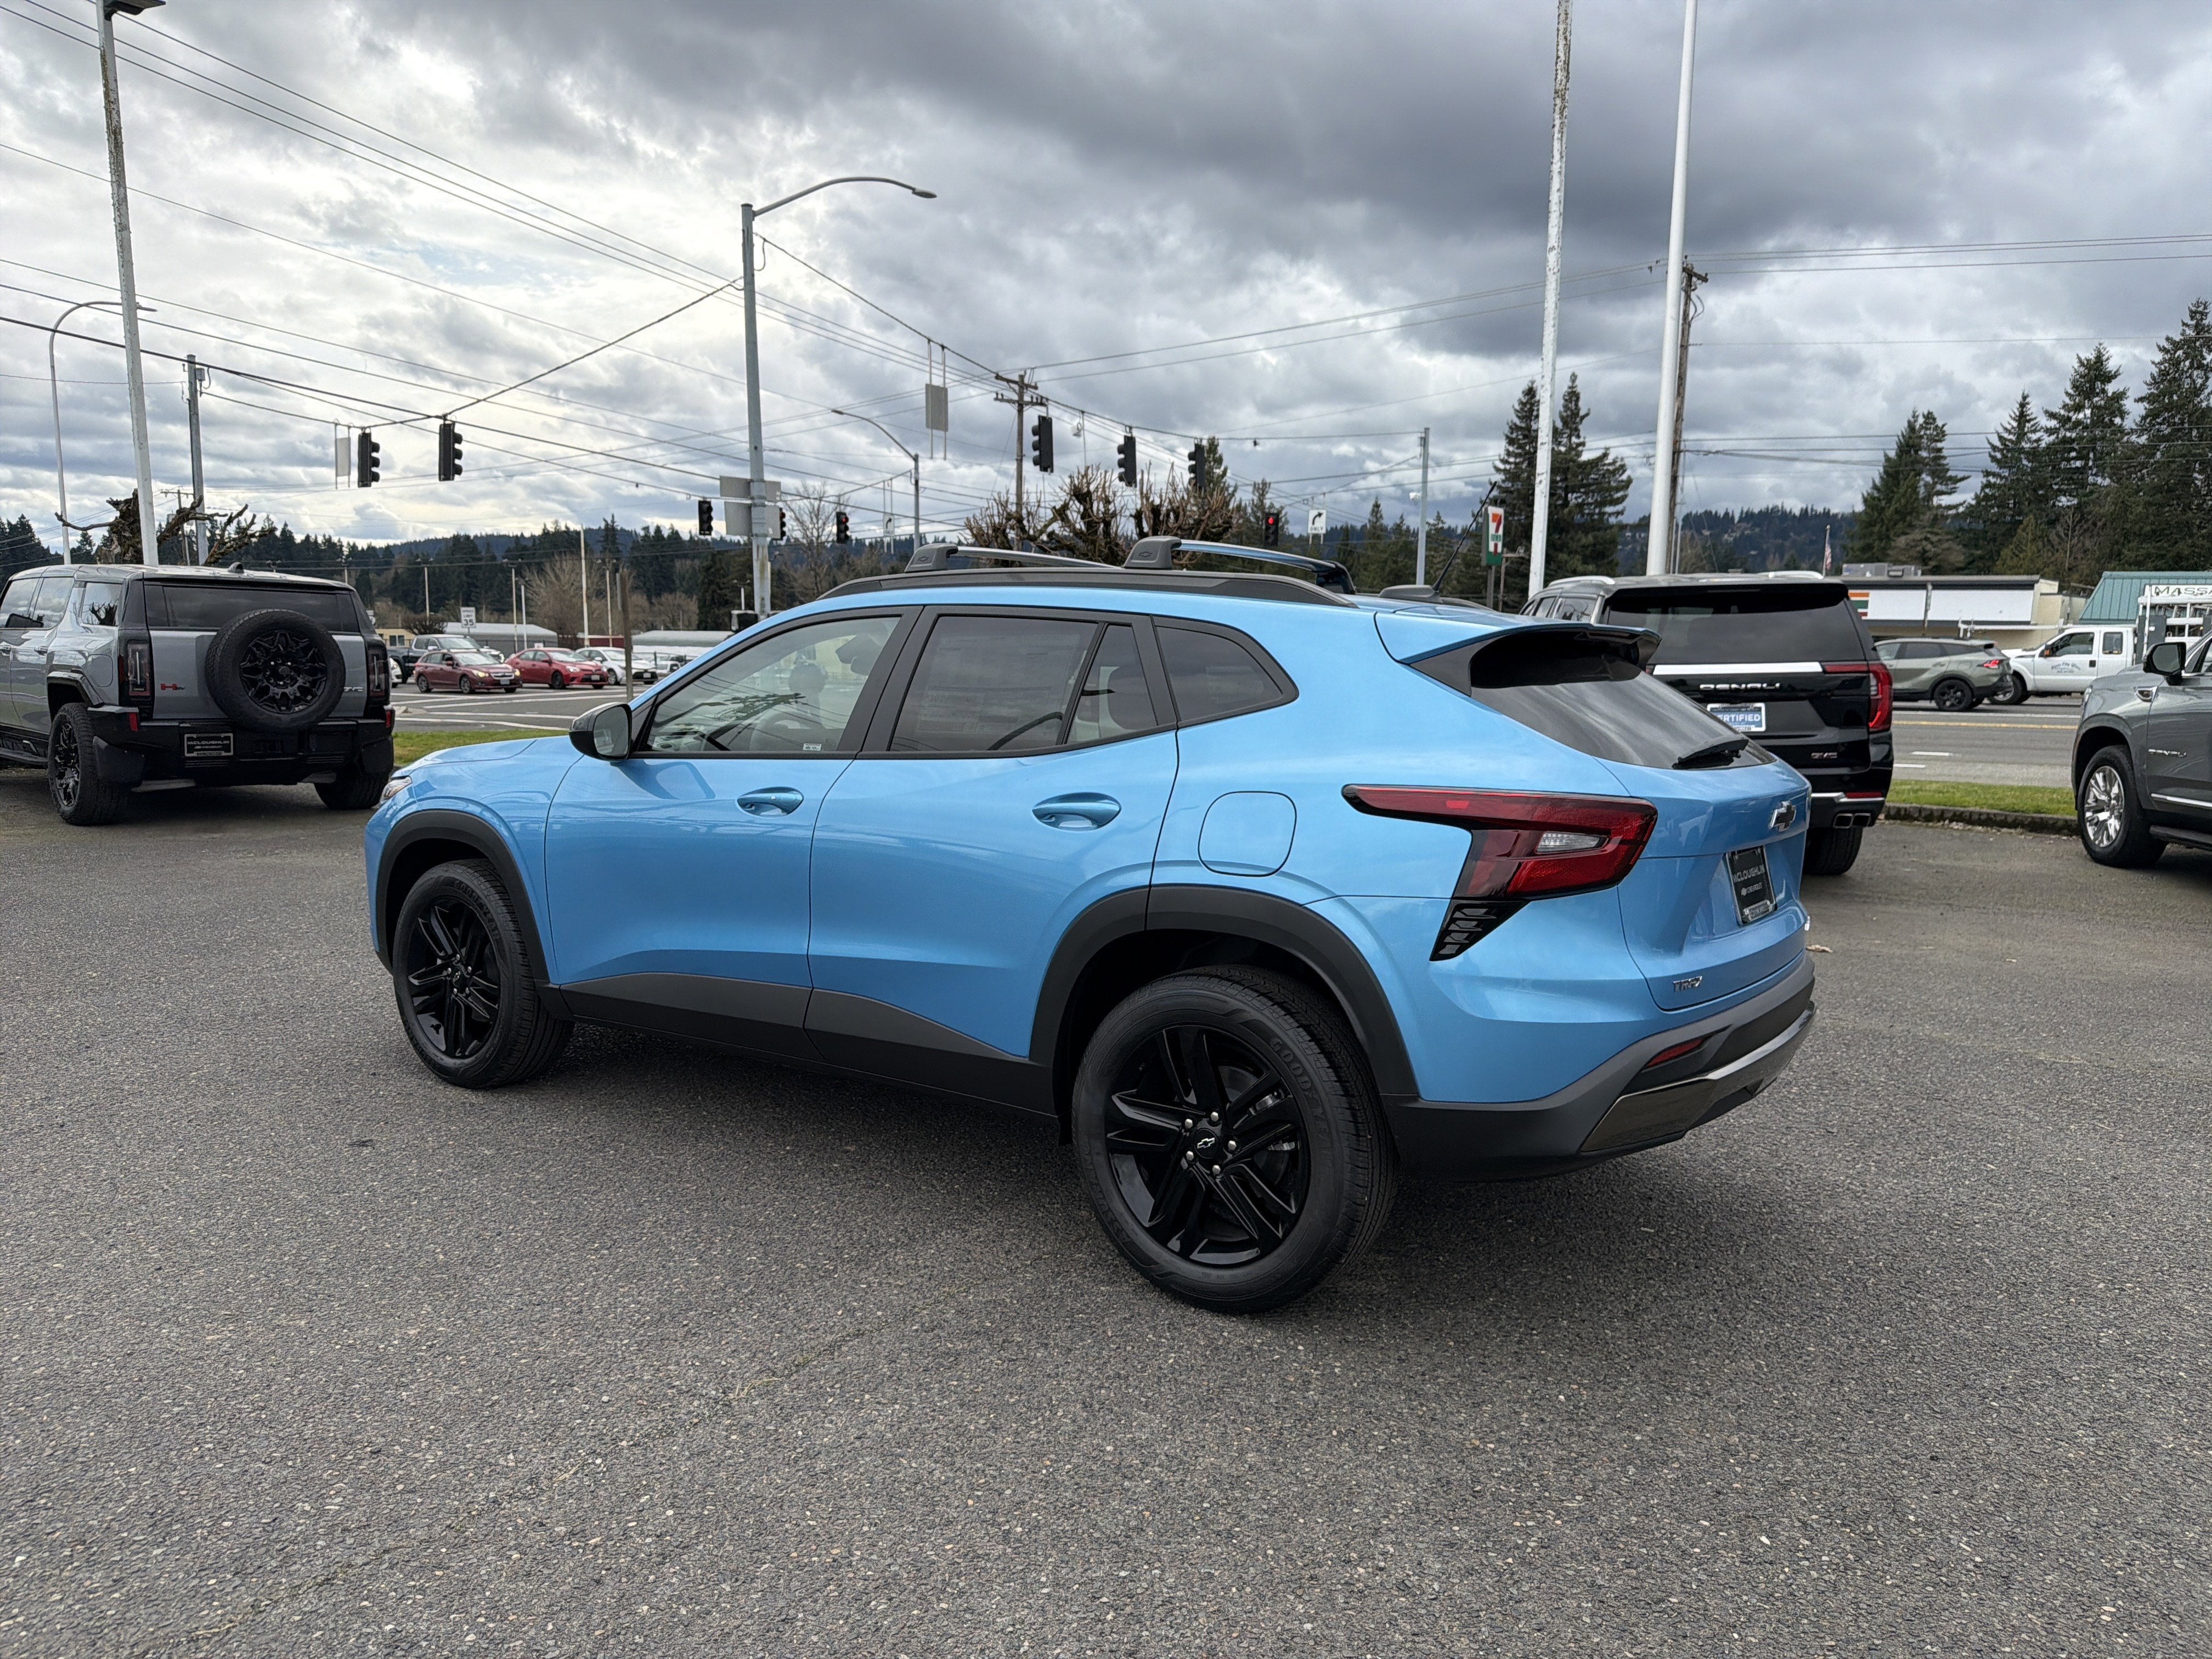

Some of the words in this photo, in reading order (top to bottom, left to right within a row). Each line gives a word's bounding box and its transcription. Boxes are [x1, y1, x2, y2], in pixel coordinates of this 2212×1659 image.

[1717, 714, 1760, 722] ERTIFIED
[1732, 864, 1765, 883] MCLOUGHLIN
[1673, 975, 1703, 991] TRAX
